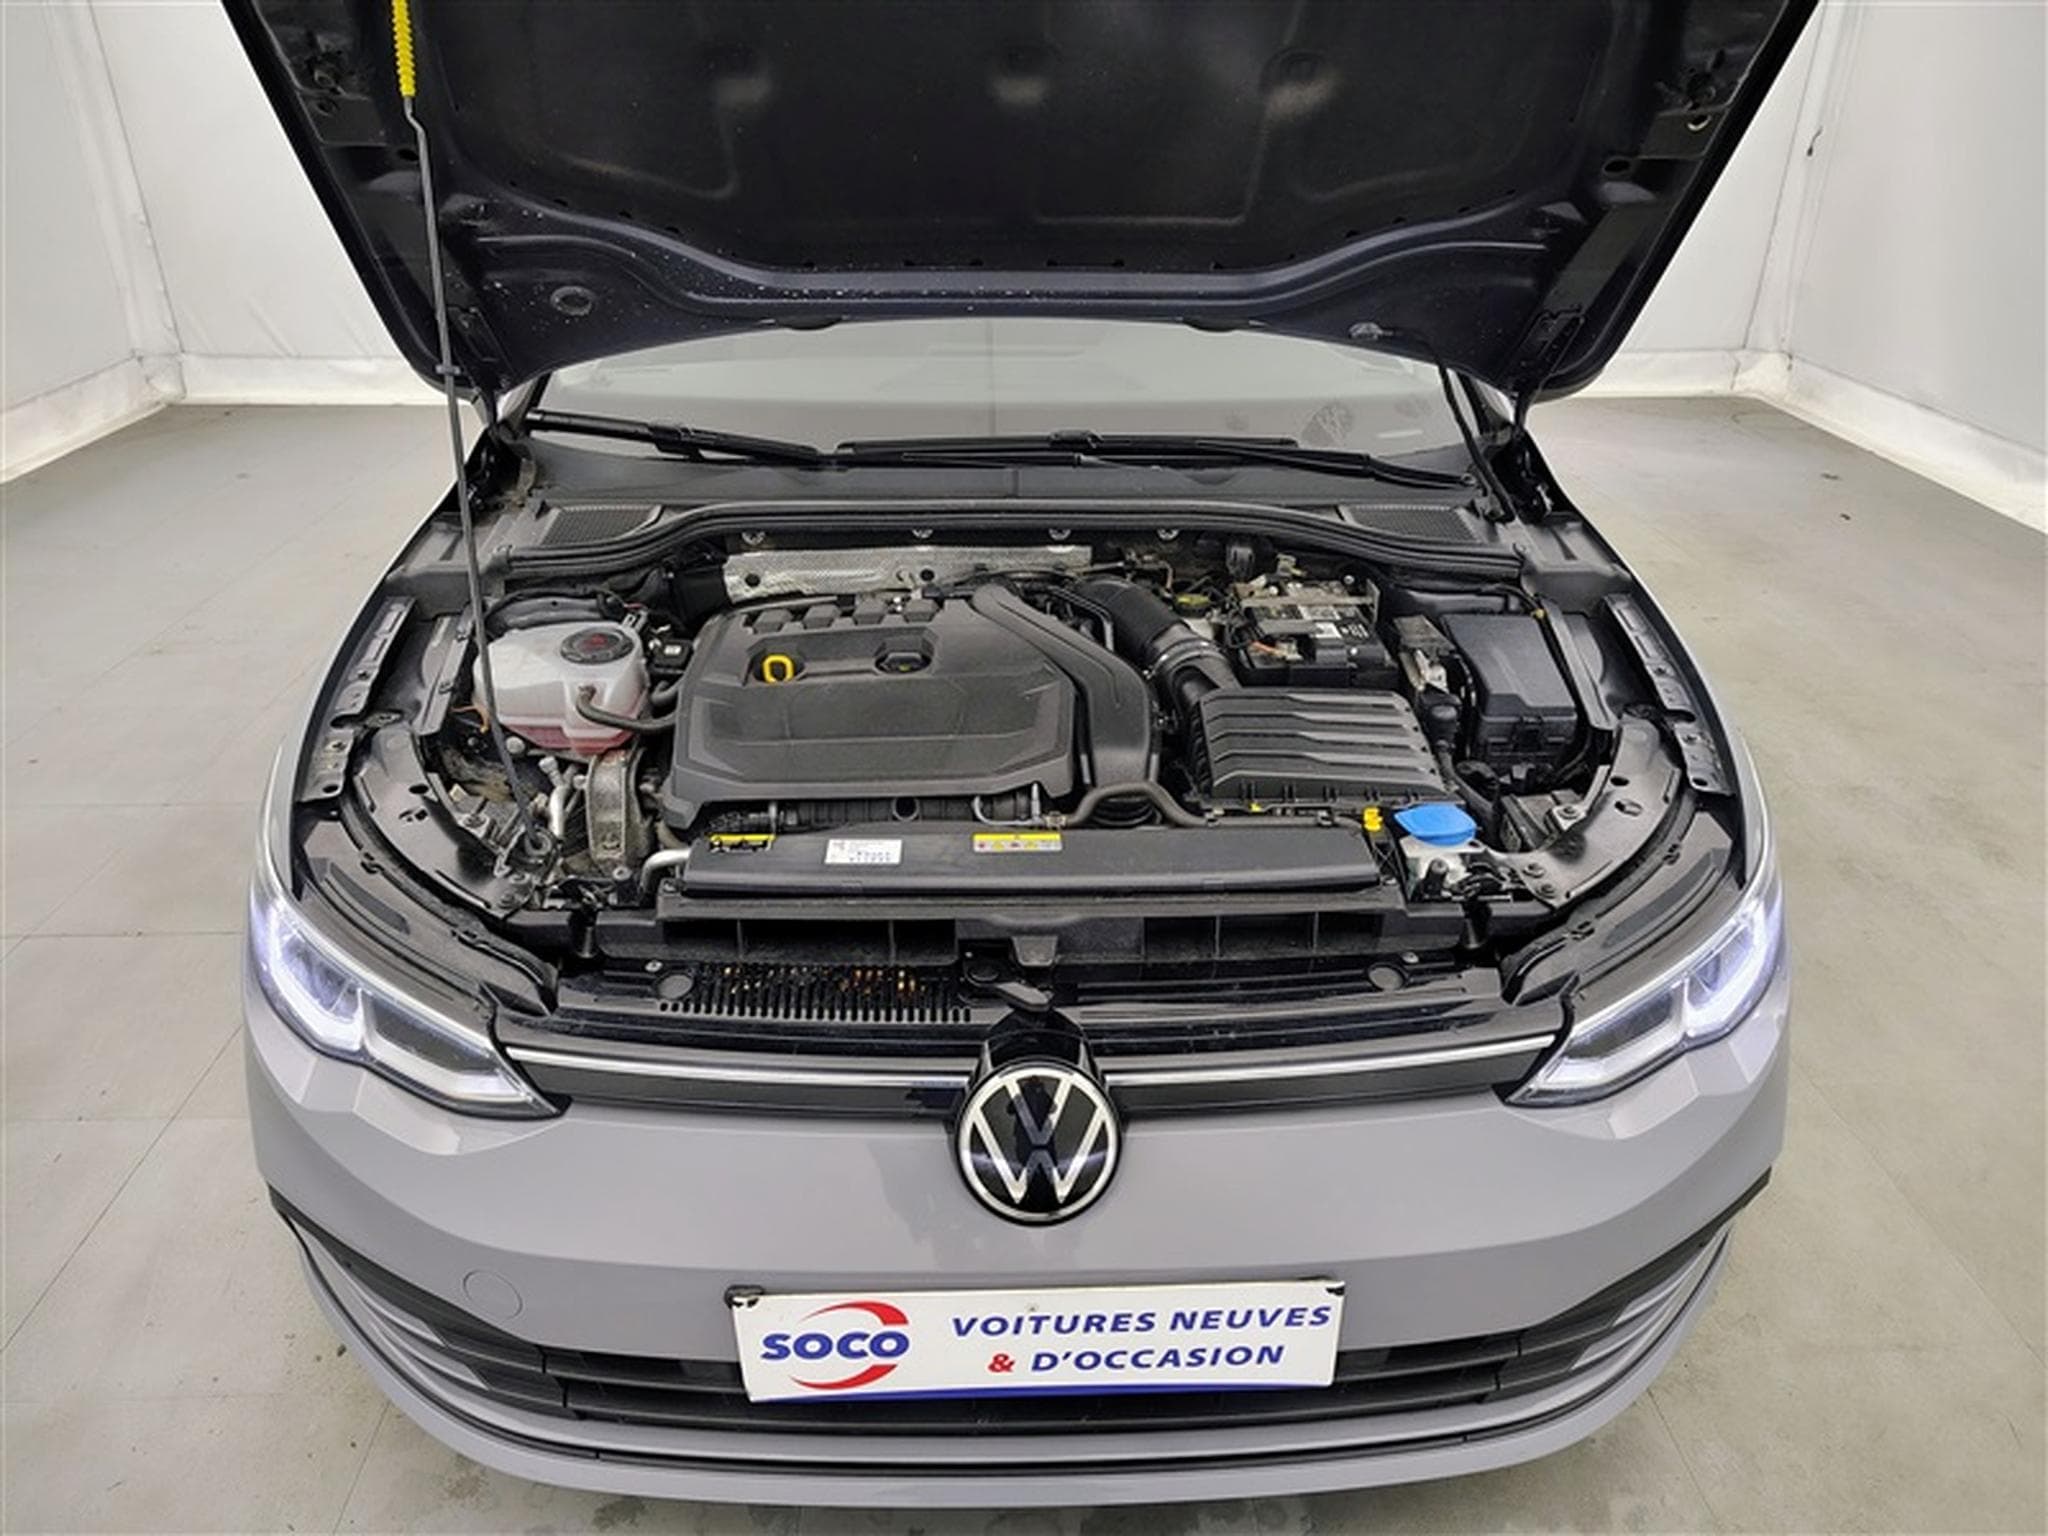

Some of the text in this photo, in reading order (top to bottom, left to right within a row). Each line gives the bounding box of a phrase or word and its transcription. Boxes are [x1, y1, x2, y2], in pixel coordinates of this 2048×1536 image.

[952, 1305, 1332, 1337] VOITURES NEUVES
[760, 1330, 910, 1361] SOCO
[987, 1353, 1015, 1373] &
